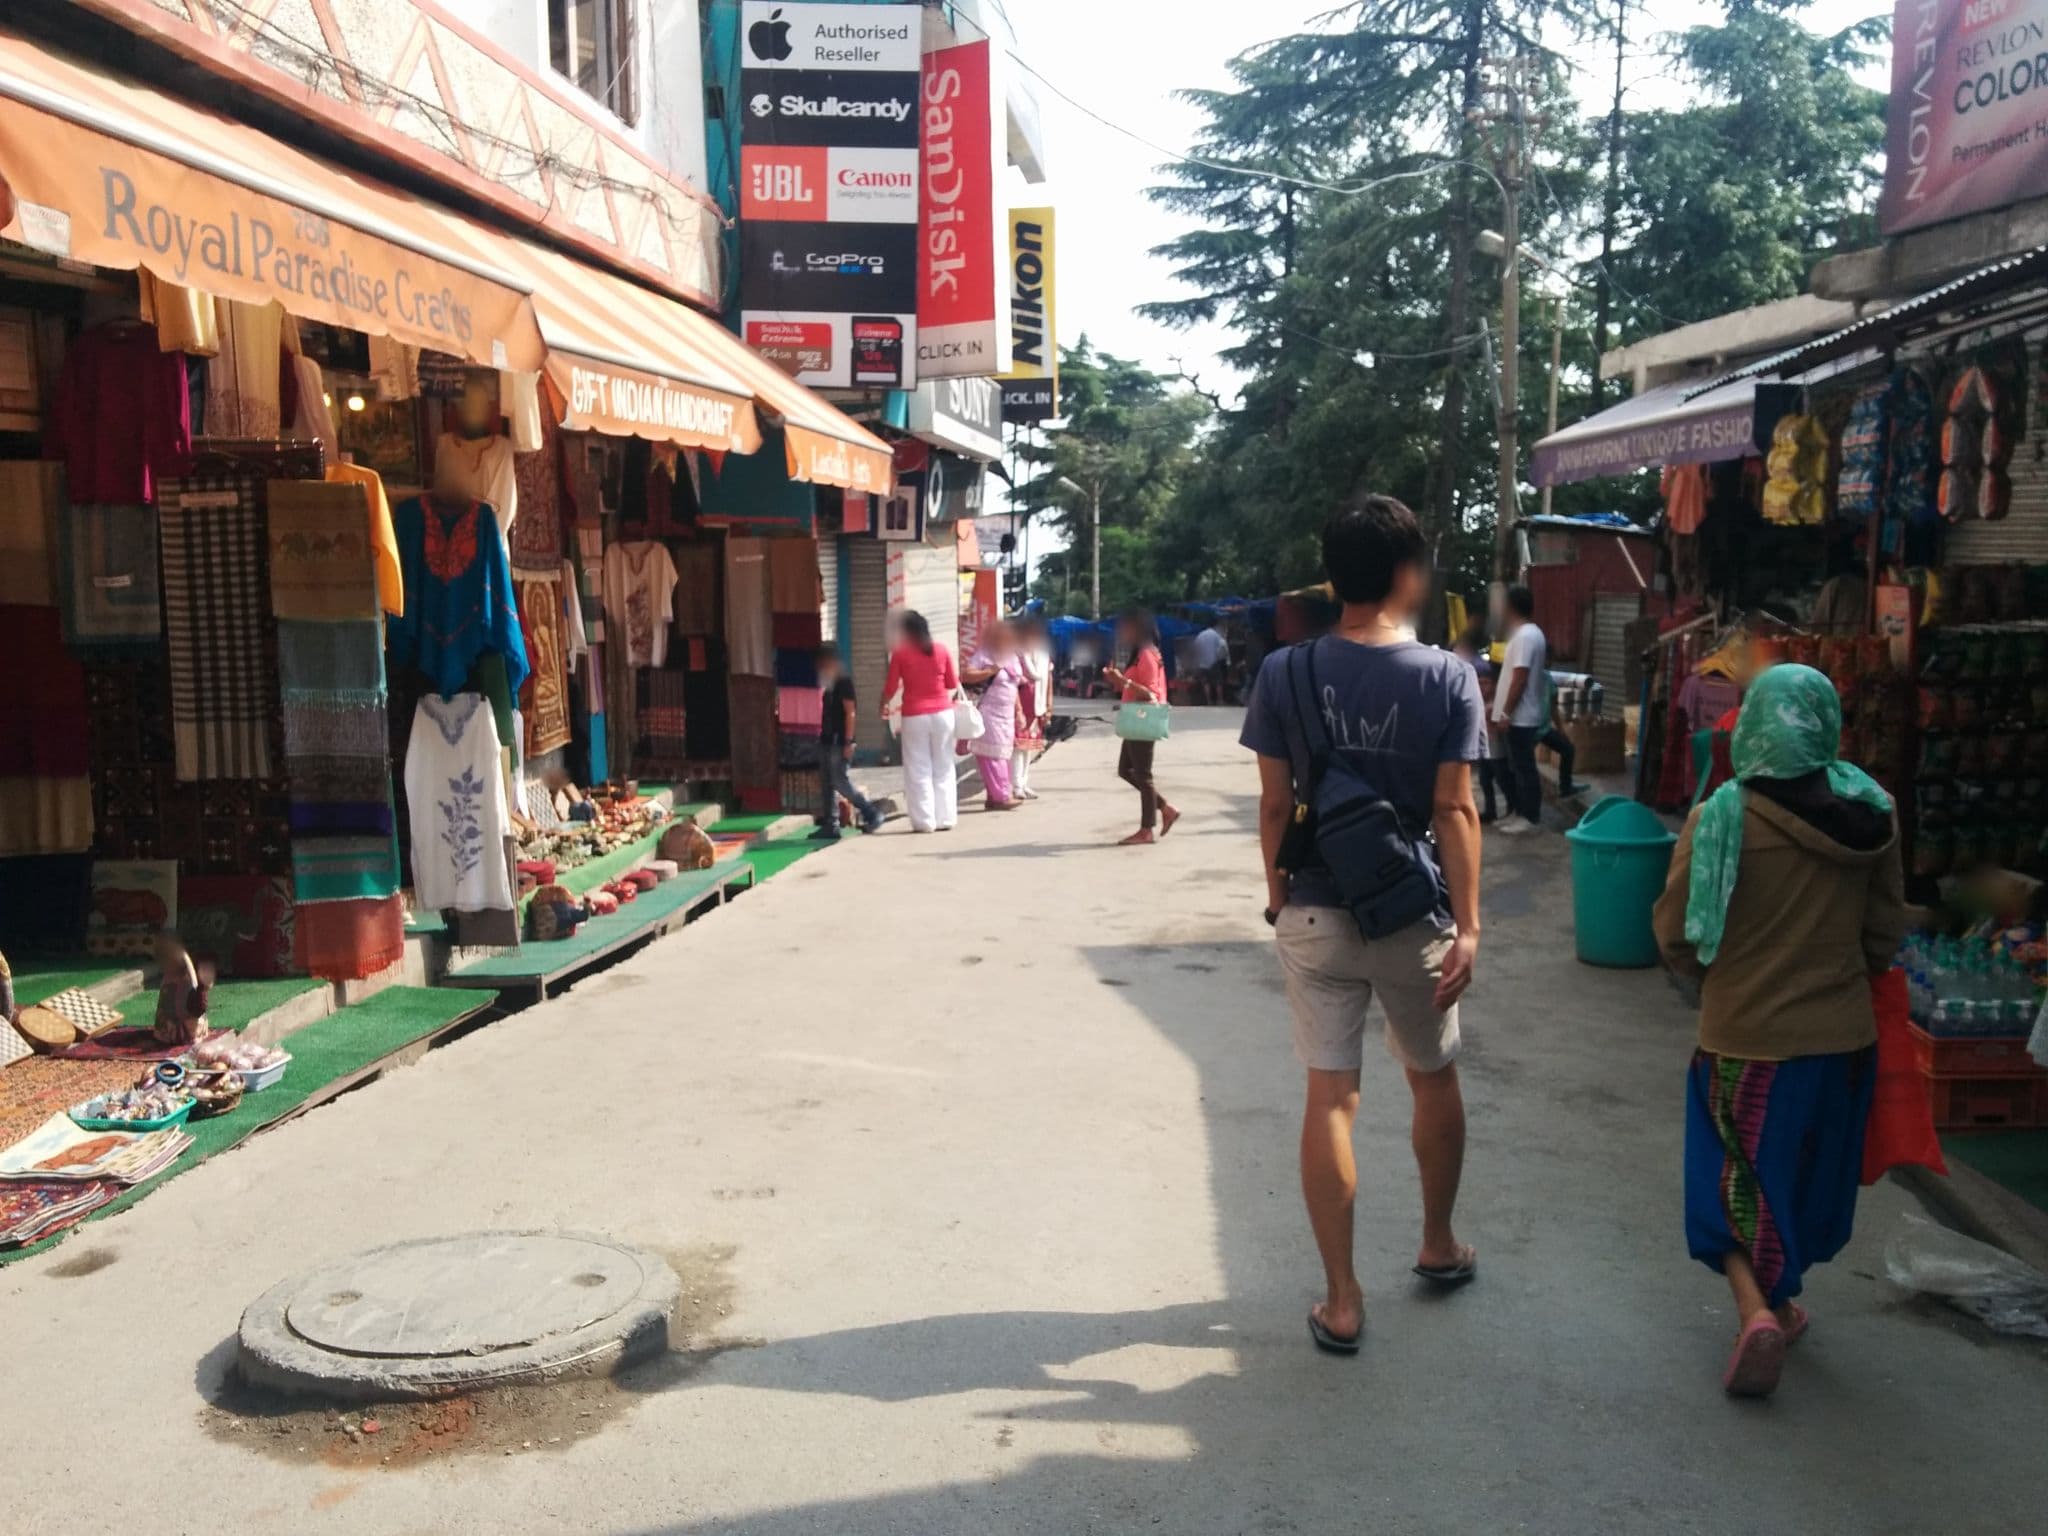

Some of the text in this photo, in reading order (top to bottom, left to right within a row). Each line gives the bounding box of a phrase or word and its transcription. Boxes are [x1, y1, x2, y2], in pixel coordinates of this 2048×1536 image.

[1964, 0, 2007, 27] NEW
[815, 23, 908, 40] Authorised
[1956, 17, 2045, 71] REVLON
[815, 46, 880, 62] Reseller
[780, 95, 911, 122] Skullcandy
[1904, 1, 1938, 200] REVLON
[1952, 128, 2030, 162] Permanent
[752, 165, 813, 202] JBL
[838, 169, 912, 187] Canon
[925, 67, 967, 298] SanDisk
[102, 166, 474, 343] Royal Paradise Crafts
[806, 253, 884, 265] GoPro
[1011, 220, 1043, 366] Nikon
[919, 340, 983, 361] CLICK IN
[571, 365, 608, 416] GIFT
[611, 377, 664, 426] INDIAN
[1632, 425, 1687, 459] UNIQUE
